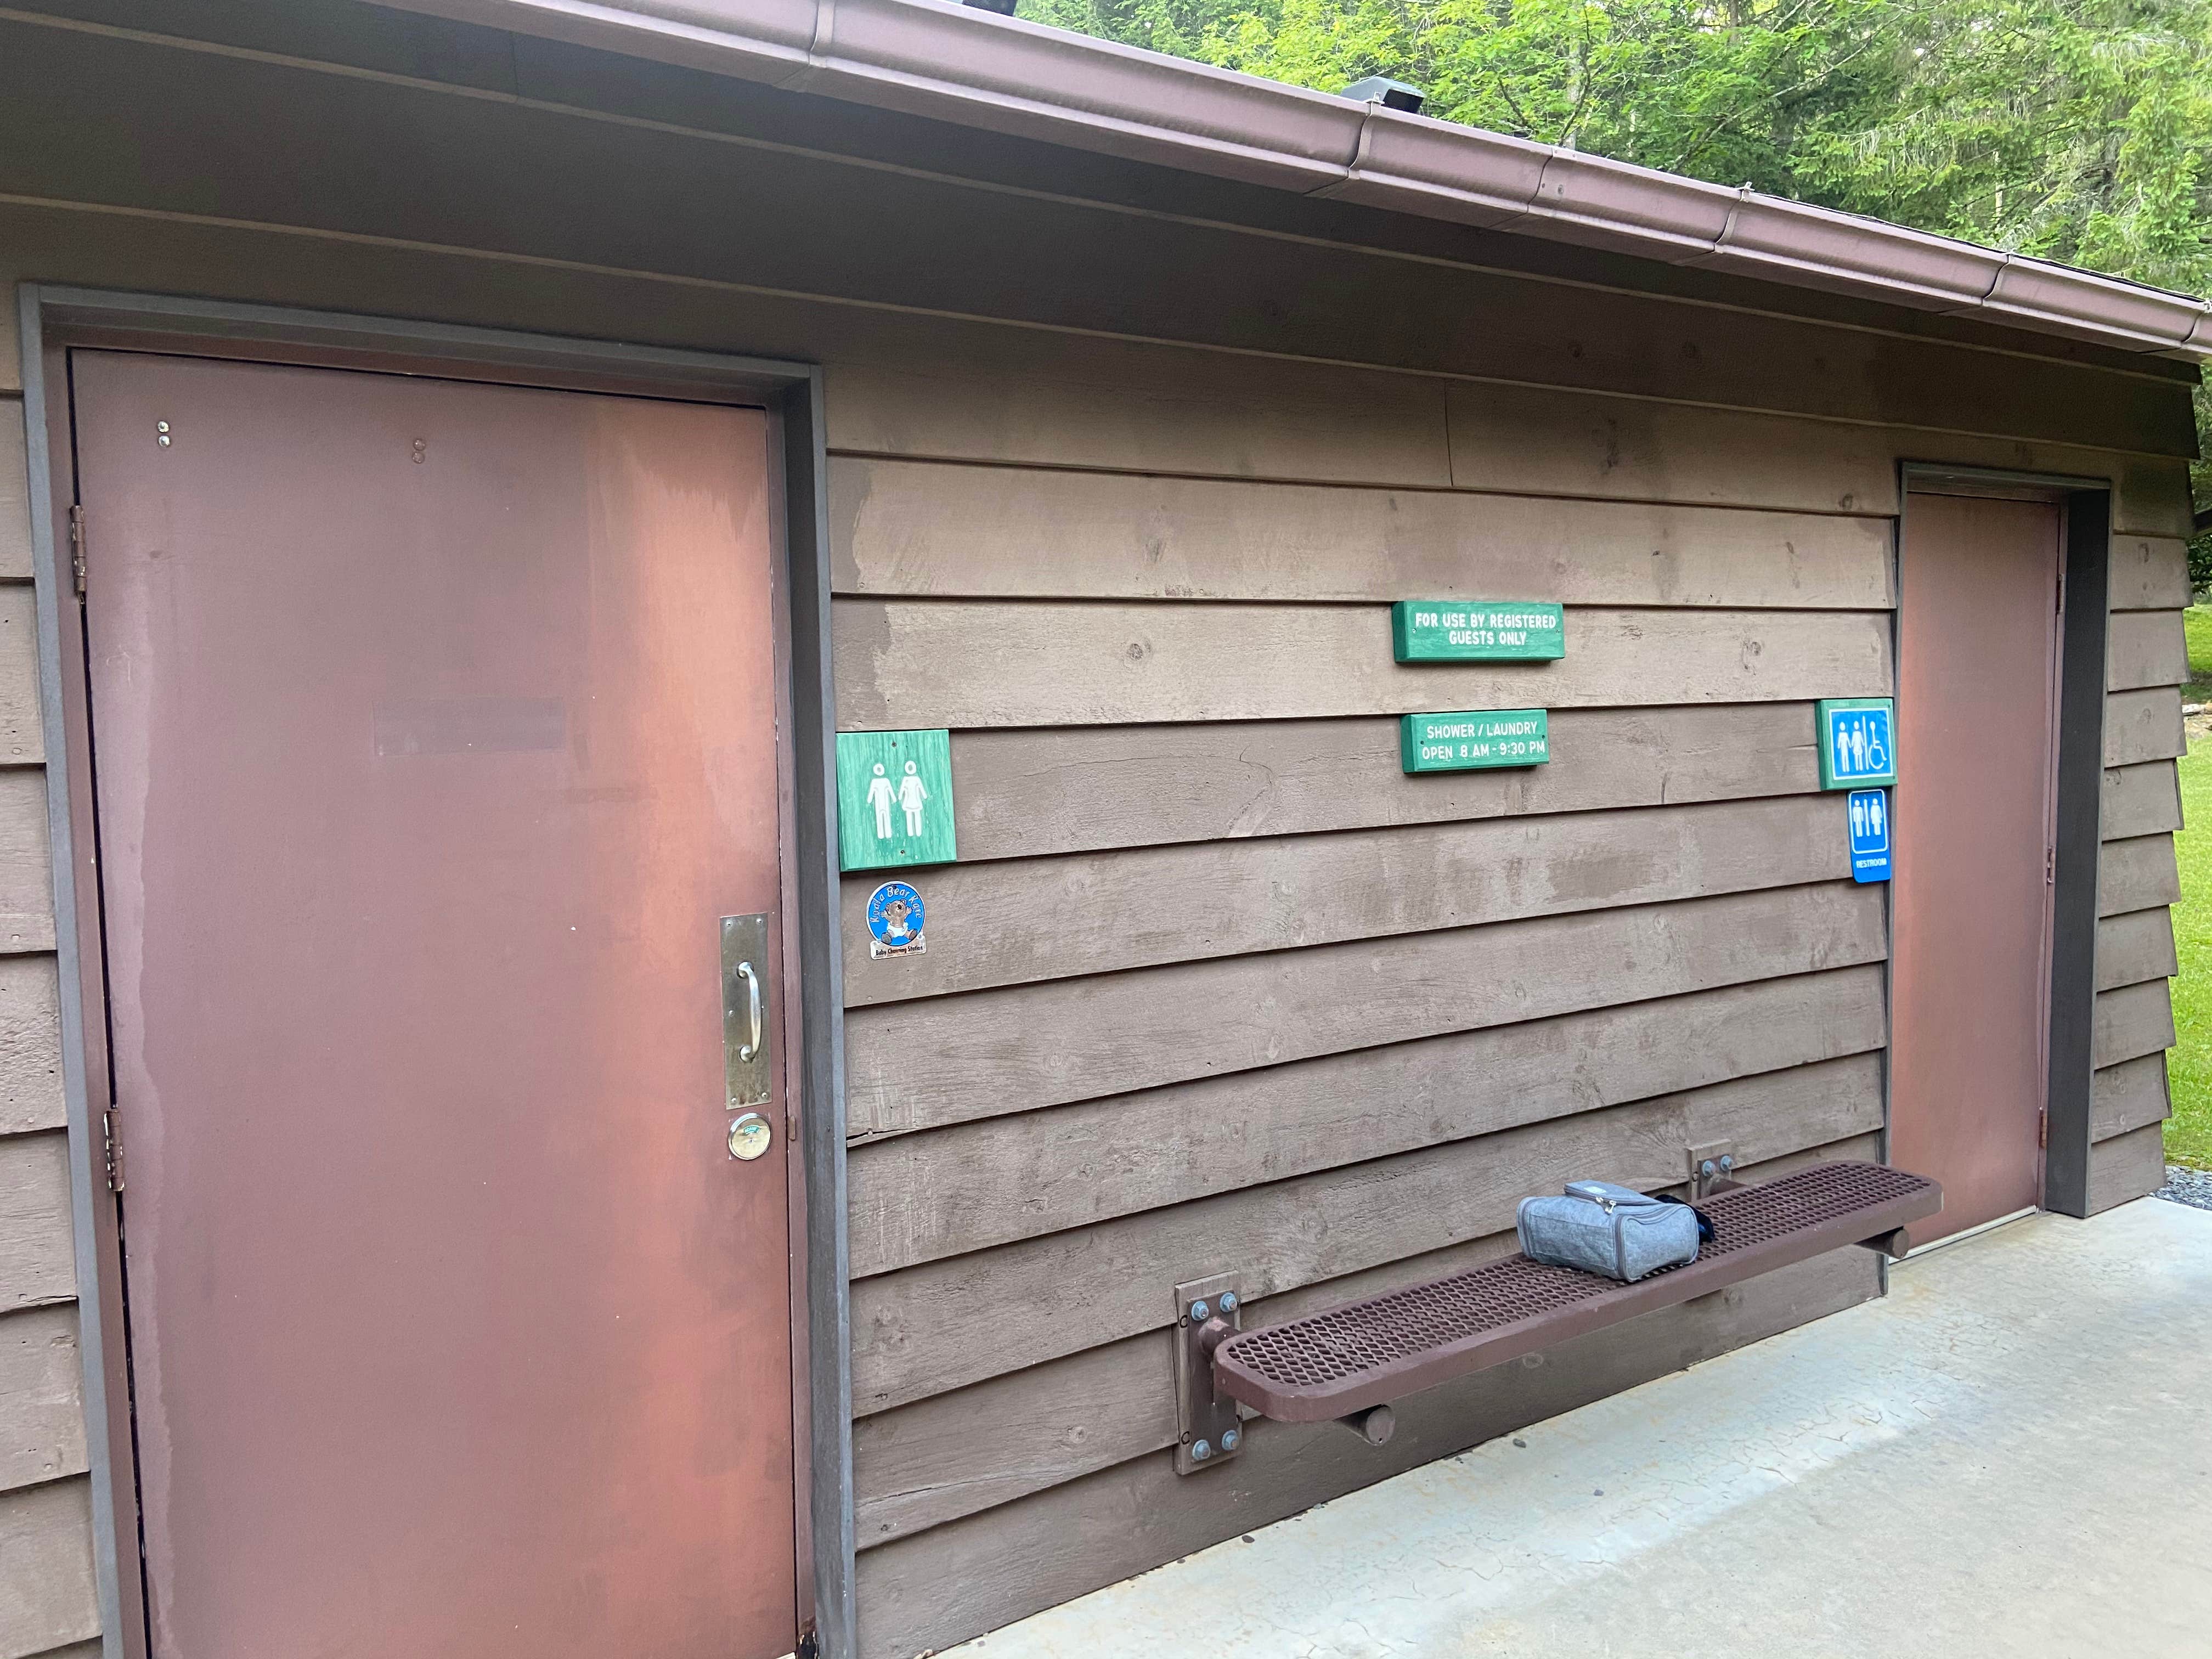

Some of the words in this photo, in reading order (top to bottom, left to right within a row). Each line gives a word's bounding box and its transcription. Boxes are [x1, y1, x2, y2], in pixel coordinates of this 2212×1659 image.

[1415, 613, 1438, 628] FOR
[1442, 613, 1466, 628] USE
[1470, 613, 1485, 628] BY
[1490, 614, 1556, 629] REGISTERED
[1449, 631, 1494, 645] GUESTS
[1499, 631, 1527, 646] ONLY
[1427, 724, 1475, 739] SHOWER
[1478, 724, 1483, 737] /
[1486, 721, 1538, 736] LAUNDRY
[1422, 746, 1453, 760] OPEN
[1460, 744, 1468, 758] 8
[1472, 744, 1489, 757] AM
[1499, 742, 1525, 755] 9:30
[1530, 741, 1545, 753] PM
[1856, 857, 1887, 868] RESTROOM
[886, 886, 911, 898] Bear
